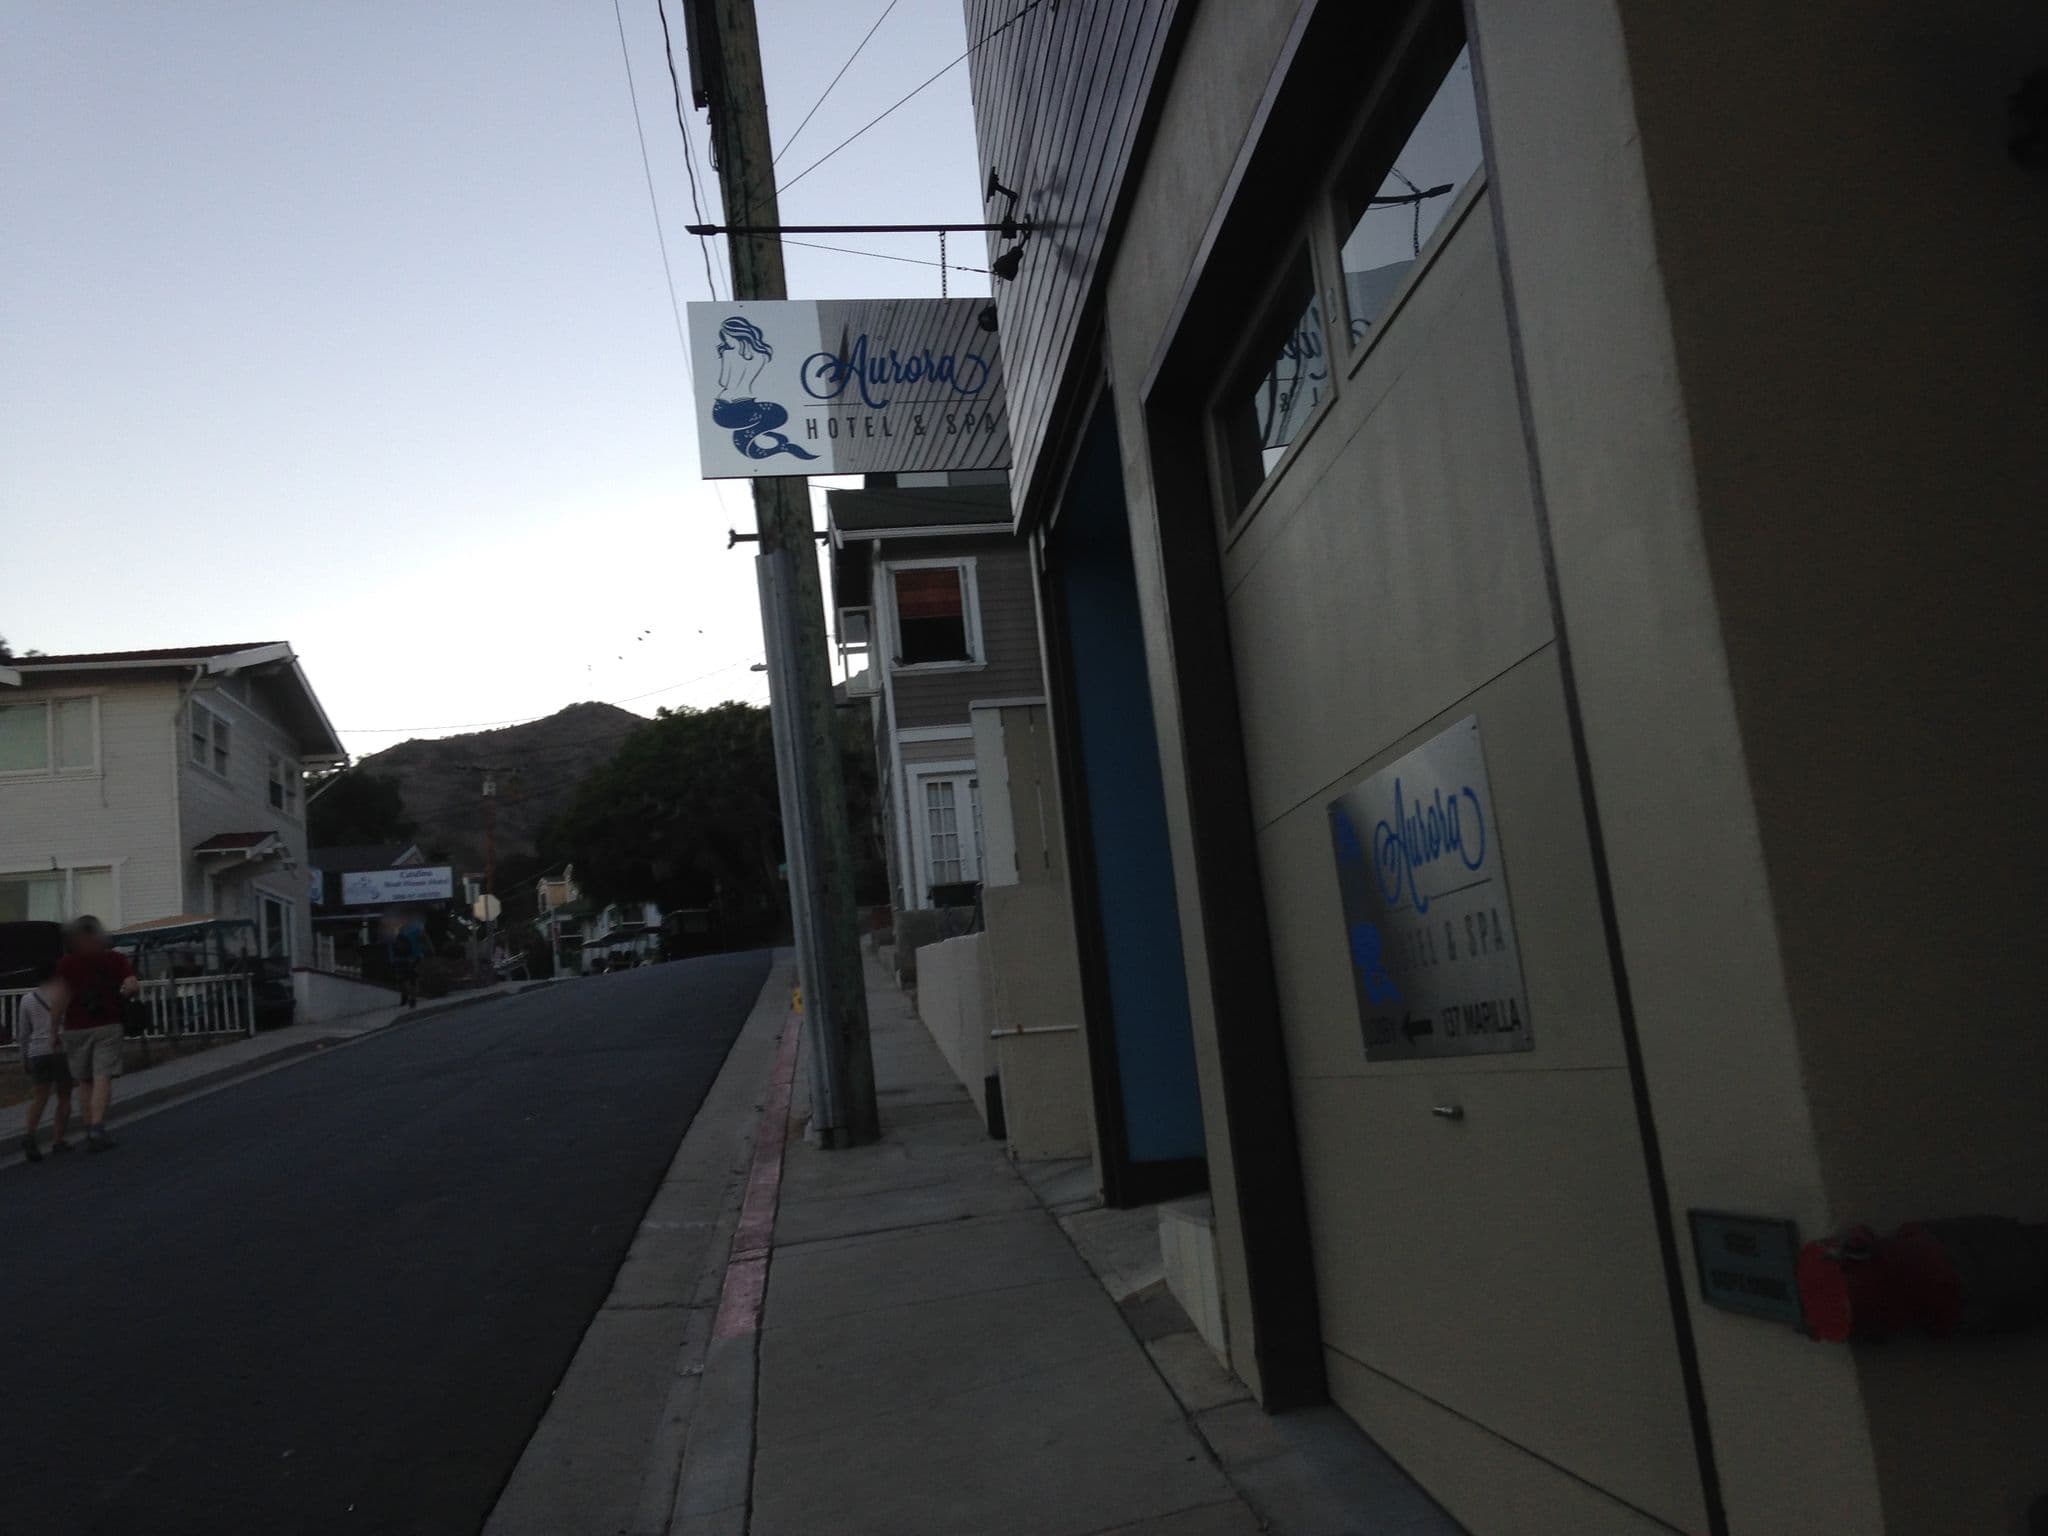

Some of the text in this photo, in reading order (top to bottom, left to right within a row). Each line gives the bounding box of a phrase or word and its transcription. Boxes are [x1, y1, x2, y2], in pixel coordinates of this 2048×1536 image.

[801, 333, 990, 409] Aurora
[807, 413, 998, 439] HOTEL & SPA
[1374, 776, 1486, 914] Aurora
[1445, 919, 1457, 962] &
[1465, 907, 1506, 958] SPA
